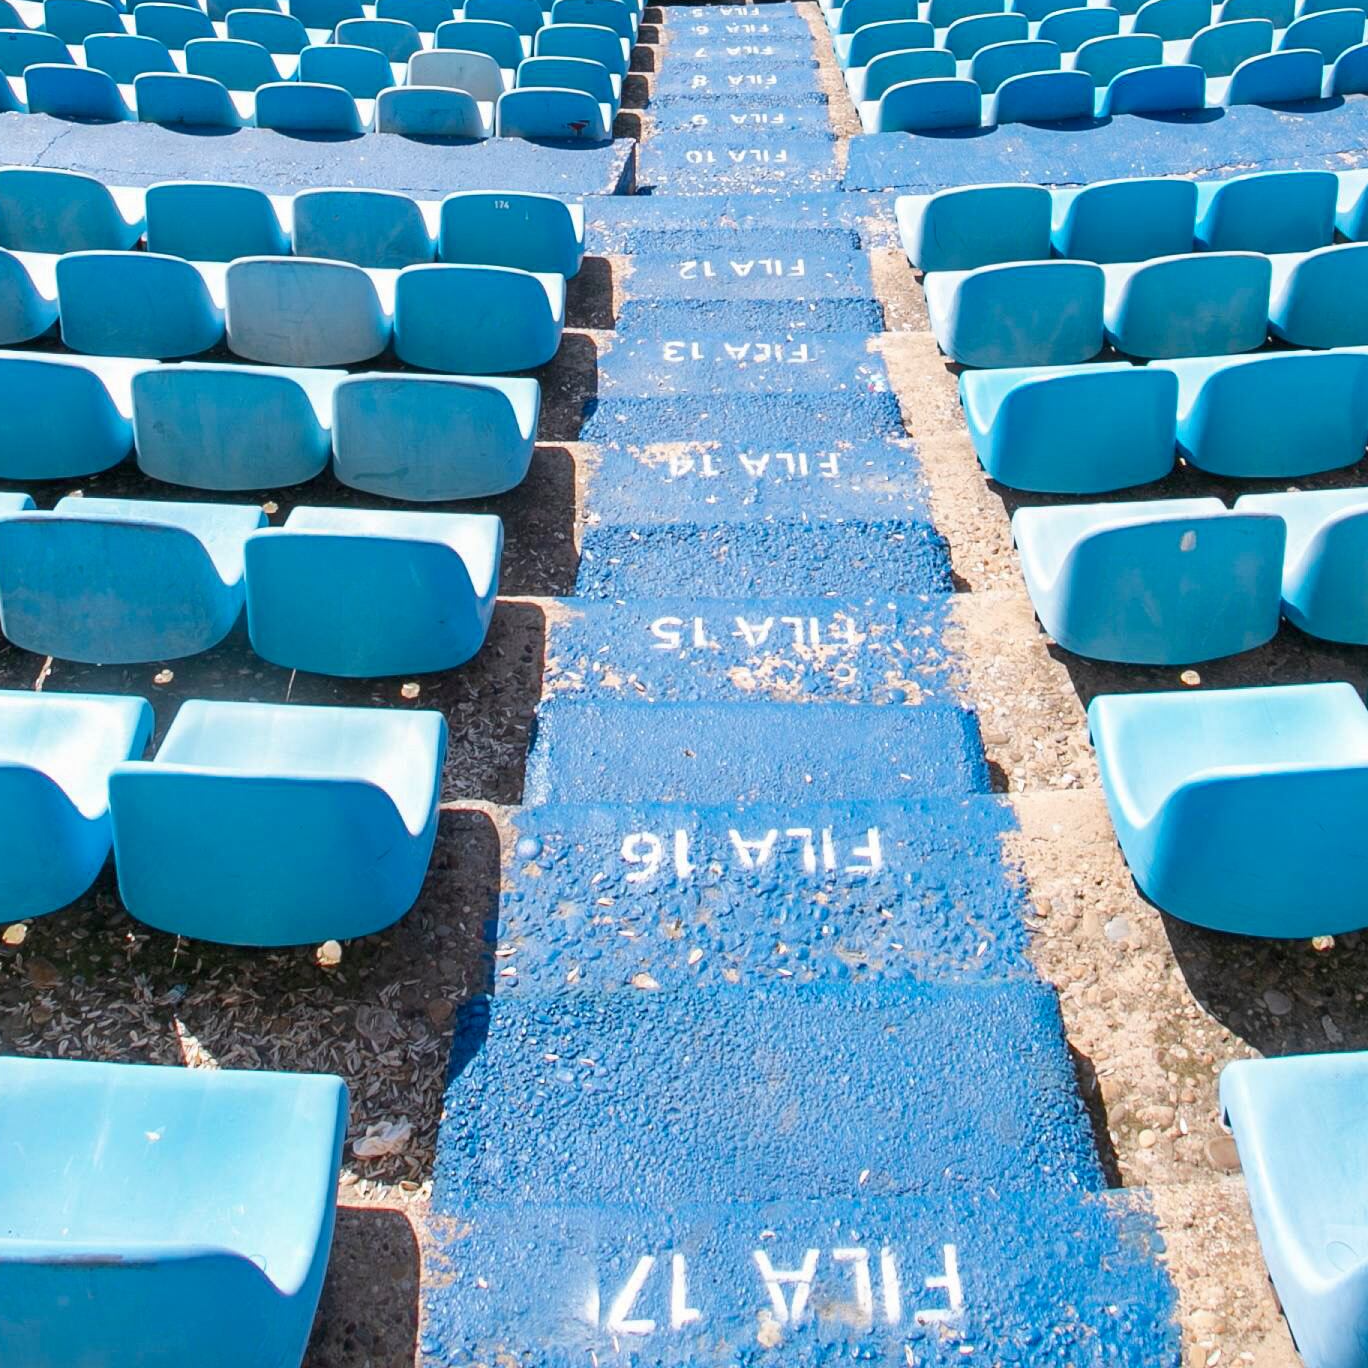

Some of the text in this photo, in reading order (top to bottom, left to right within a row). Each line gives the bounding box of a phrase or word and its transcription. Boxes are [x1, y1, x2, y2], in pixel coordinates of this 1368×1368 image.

[720, 7, 760, 17] FILA
[695, 23, 771, 35] FILA 6
[695, 46, 775, 58] FILA 7
[691, 74, 778, 88] FILA 8
[692, 113, 785, 125] FILA 9
[686, 149, 787, 164] FILA 10
[494, 200, 510, 209] 174
[680, 258, 806, 280] FILA 12
[663, 341, 705, 362] 13
[739, 452, 840, 479] FILA
[650, 615, 858, 650] FILA 15
[622, 825, 882, 882] FILA 16
[606, 1243, 965, 1333] FILA 17
